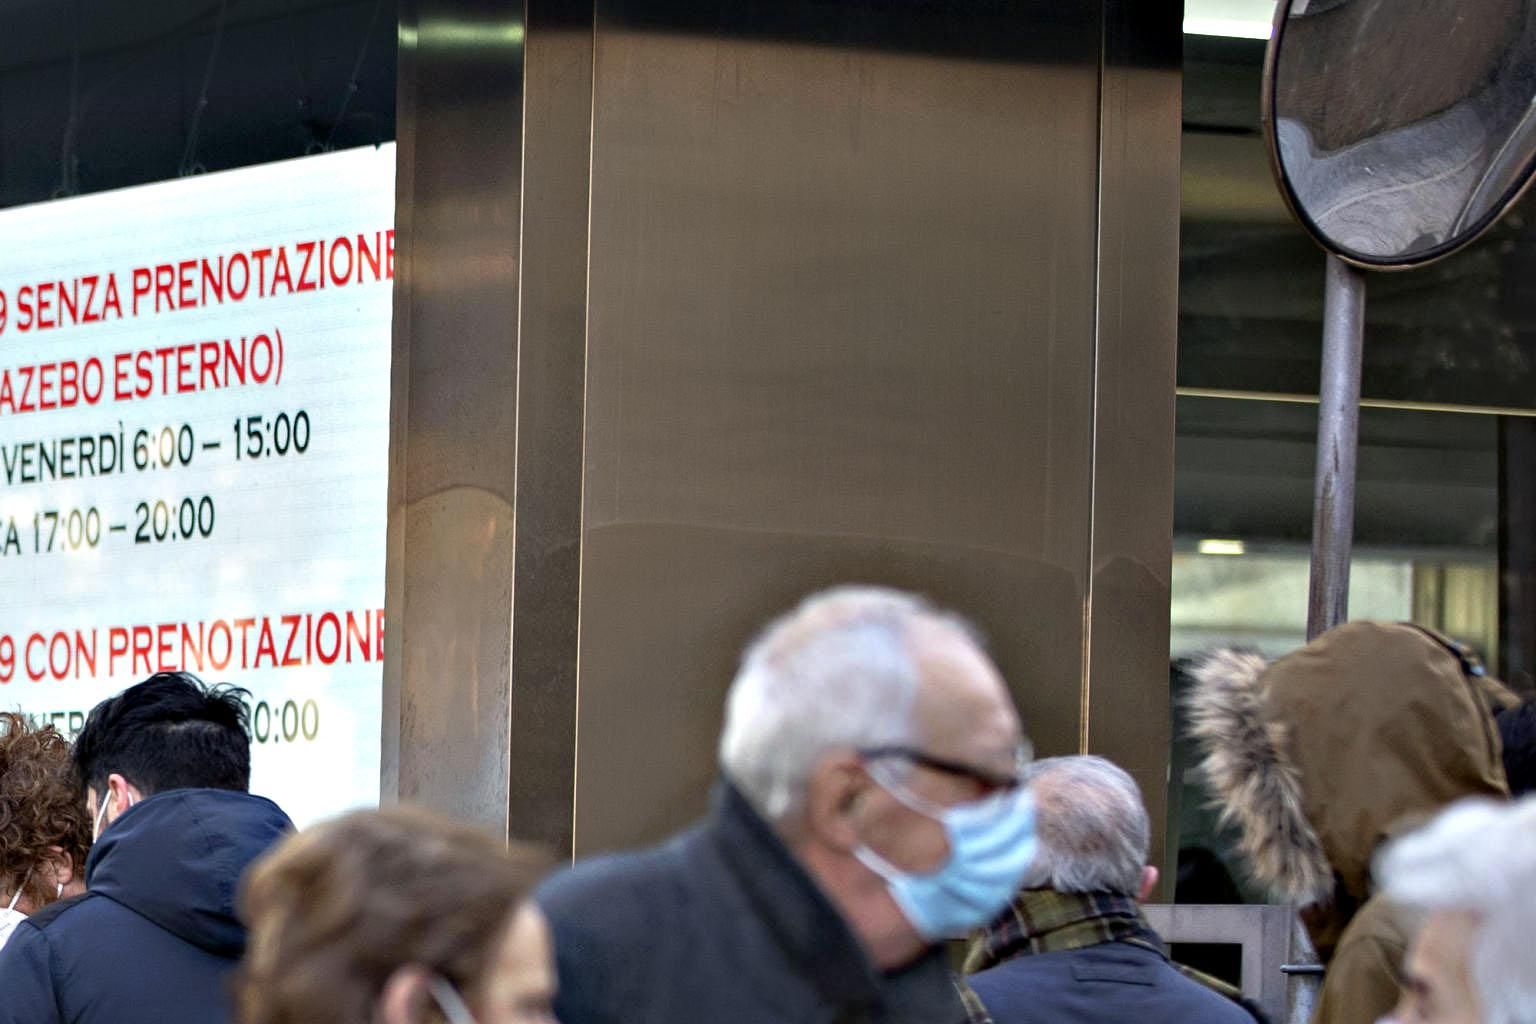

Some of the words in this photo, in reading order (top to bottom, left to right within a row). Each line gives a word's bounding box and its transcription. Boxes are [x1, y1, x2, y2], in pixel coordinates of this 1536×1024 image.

[16, 272, 123, 333] SENZA
[113, 328, 284, 401] ESTERNO)
[1, 420, 125, 486] VENERDÌ
[133, 422, 194, 472] 6:00
[233, 410, 311, 461] 15:00
[33, 506, 101, 555] 17:00
[134, 494, 216, 546] 20:00
[24, 629, 98, 684] CON
